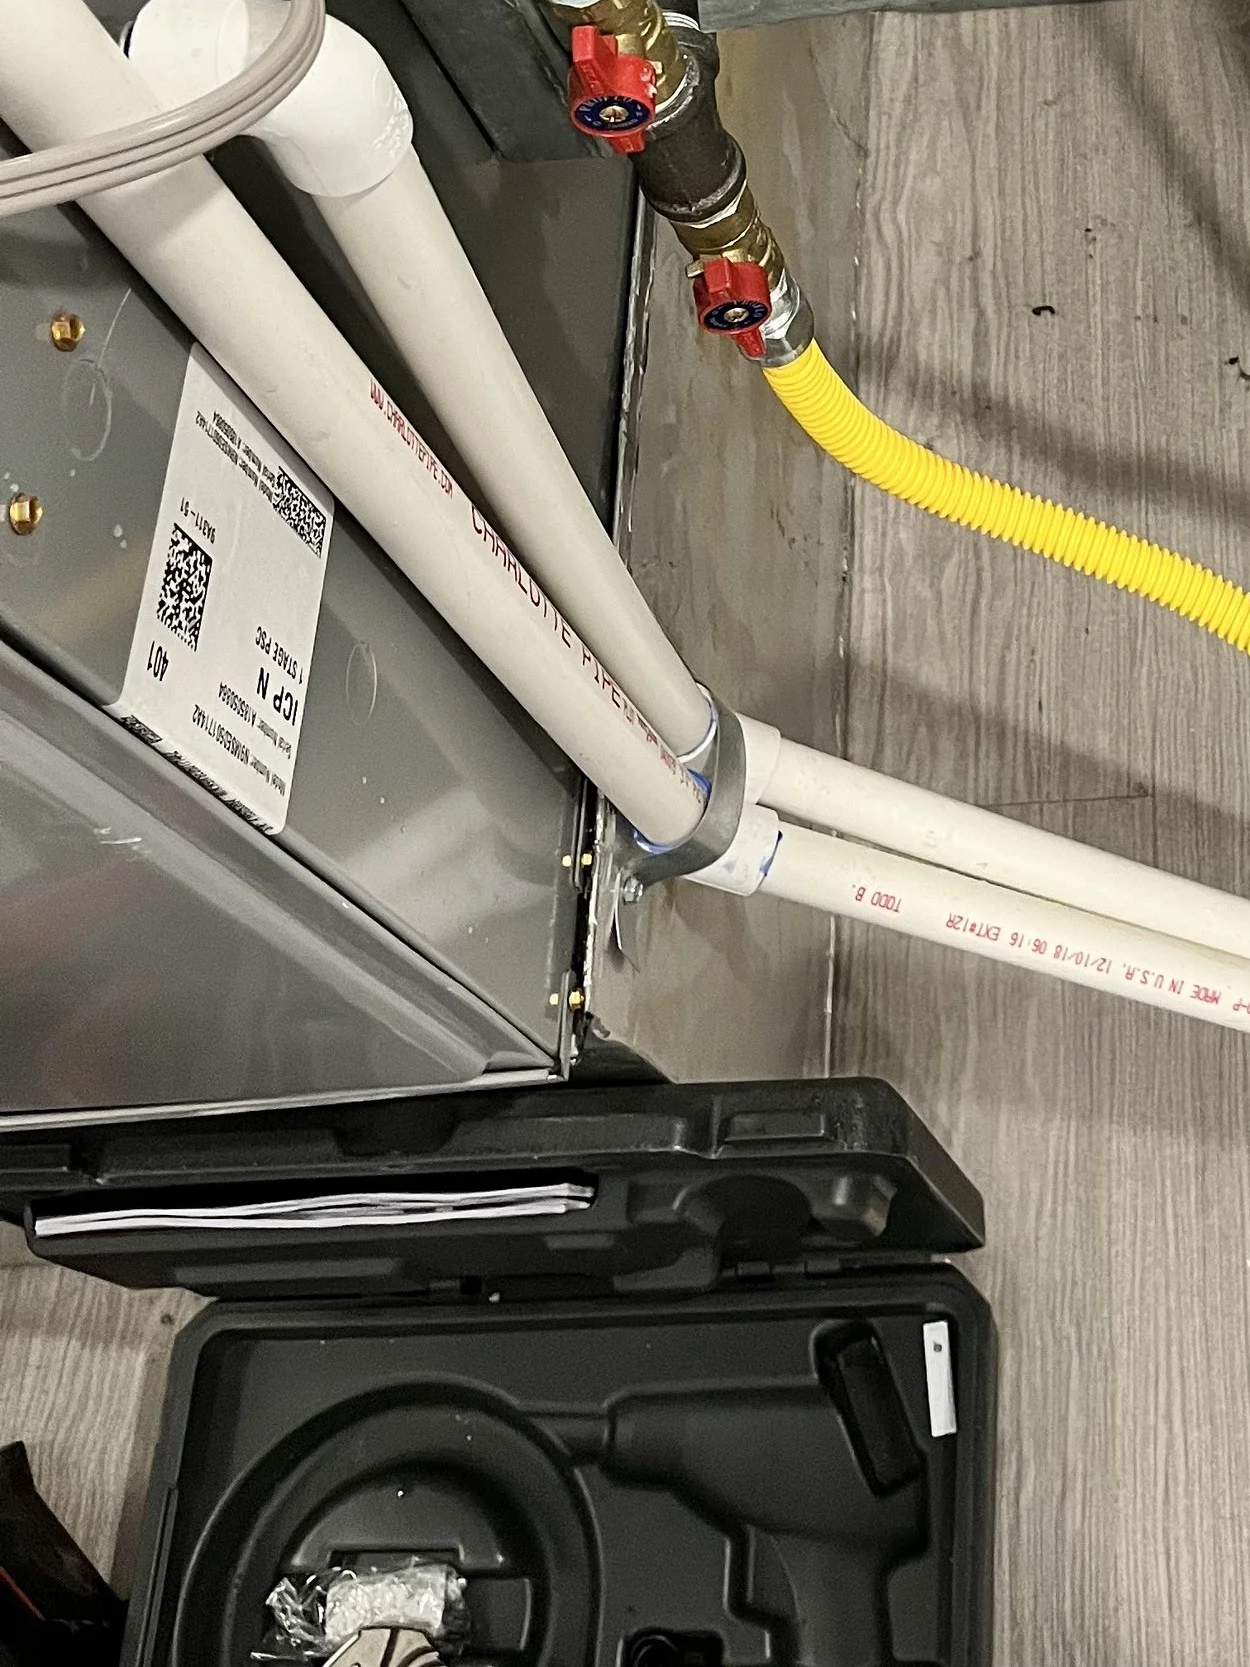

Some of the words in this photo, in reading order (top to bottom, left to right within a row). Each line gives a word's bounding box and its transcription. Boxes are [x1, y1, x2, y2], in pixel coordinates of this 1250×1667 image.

[471, 505, 571, 651] CHARLOTTE
[579, 648, 628, 708] PIPE
[254, 625, 272, 655] PSC
[146, 639, 169, 681] 401
[271, 641, 297, 679] STAGE
[255, 666, 270, 700] N
[298, 667, 303, 685] 1
[272, 685, 298, 726] ICP
[852, 884, 866, 902] B.
[869, 890, 901, 913] TODD
[945, 913, 1001, 941] EXT#12R
[1008, 931, 1047, 955] 06:16
[1052, 943, 1112, 974] 12/10/18
[1122, 963, 1164, 989] U.S.A.
[1167, 978, 1184, 995] IN
[1189, 983, 1221, 1005] MADE
